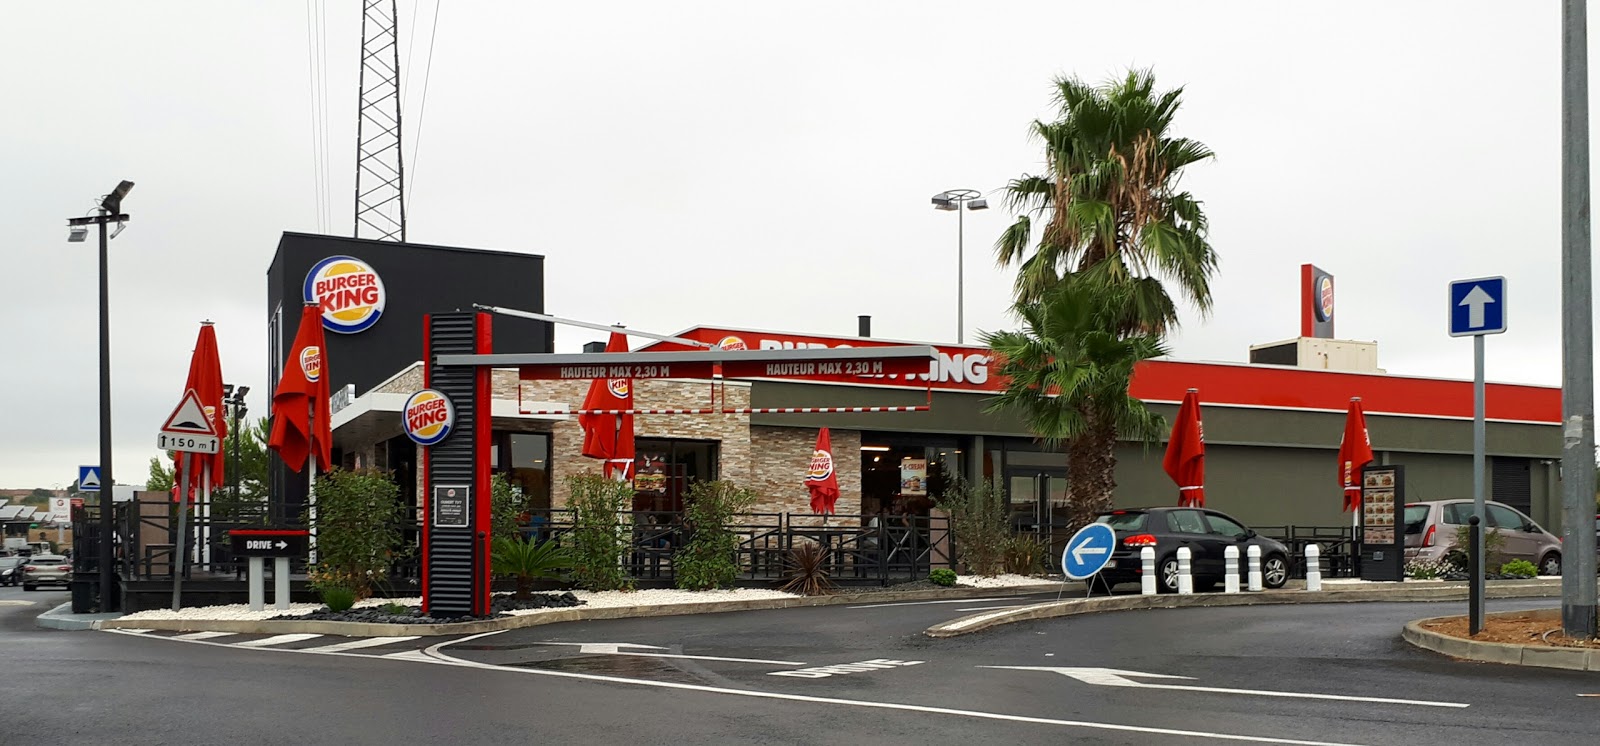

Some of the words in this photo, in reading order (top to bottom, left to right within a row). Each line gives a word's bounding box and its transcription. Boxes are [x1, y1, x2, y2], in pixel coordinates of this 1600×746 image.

[316, 273, 376, 296] BURGER
[319, 286, 379, 314] KING
[560, 366, 606, 379] HAUTEUR
[609, 366, 632, 378] MAX
[634, 365, 658, 378] 2,30
[660, 365, 670, 377] M
[766, 362, 815, 376] HAUTEUR
[817, 362, 842, 375] MAX
[845, 361, 870, 375] 2,30
[872, 361, 883, 374] M
[611, 379, 627, 390] KIN
[407, 398, 446, 420] BURGER
[408, 408, 448, 433] KING
[170, 437, 195, 449] 150
[246, 540, 272, 550] DRIVE
[766, 658, 926, 679] DRIVE
